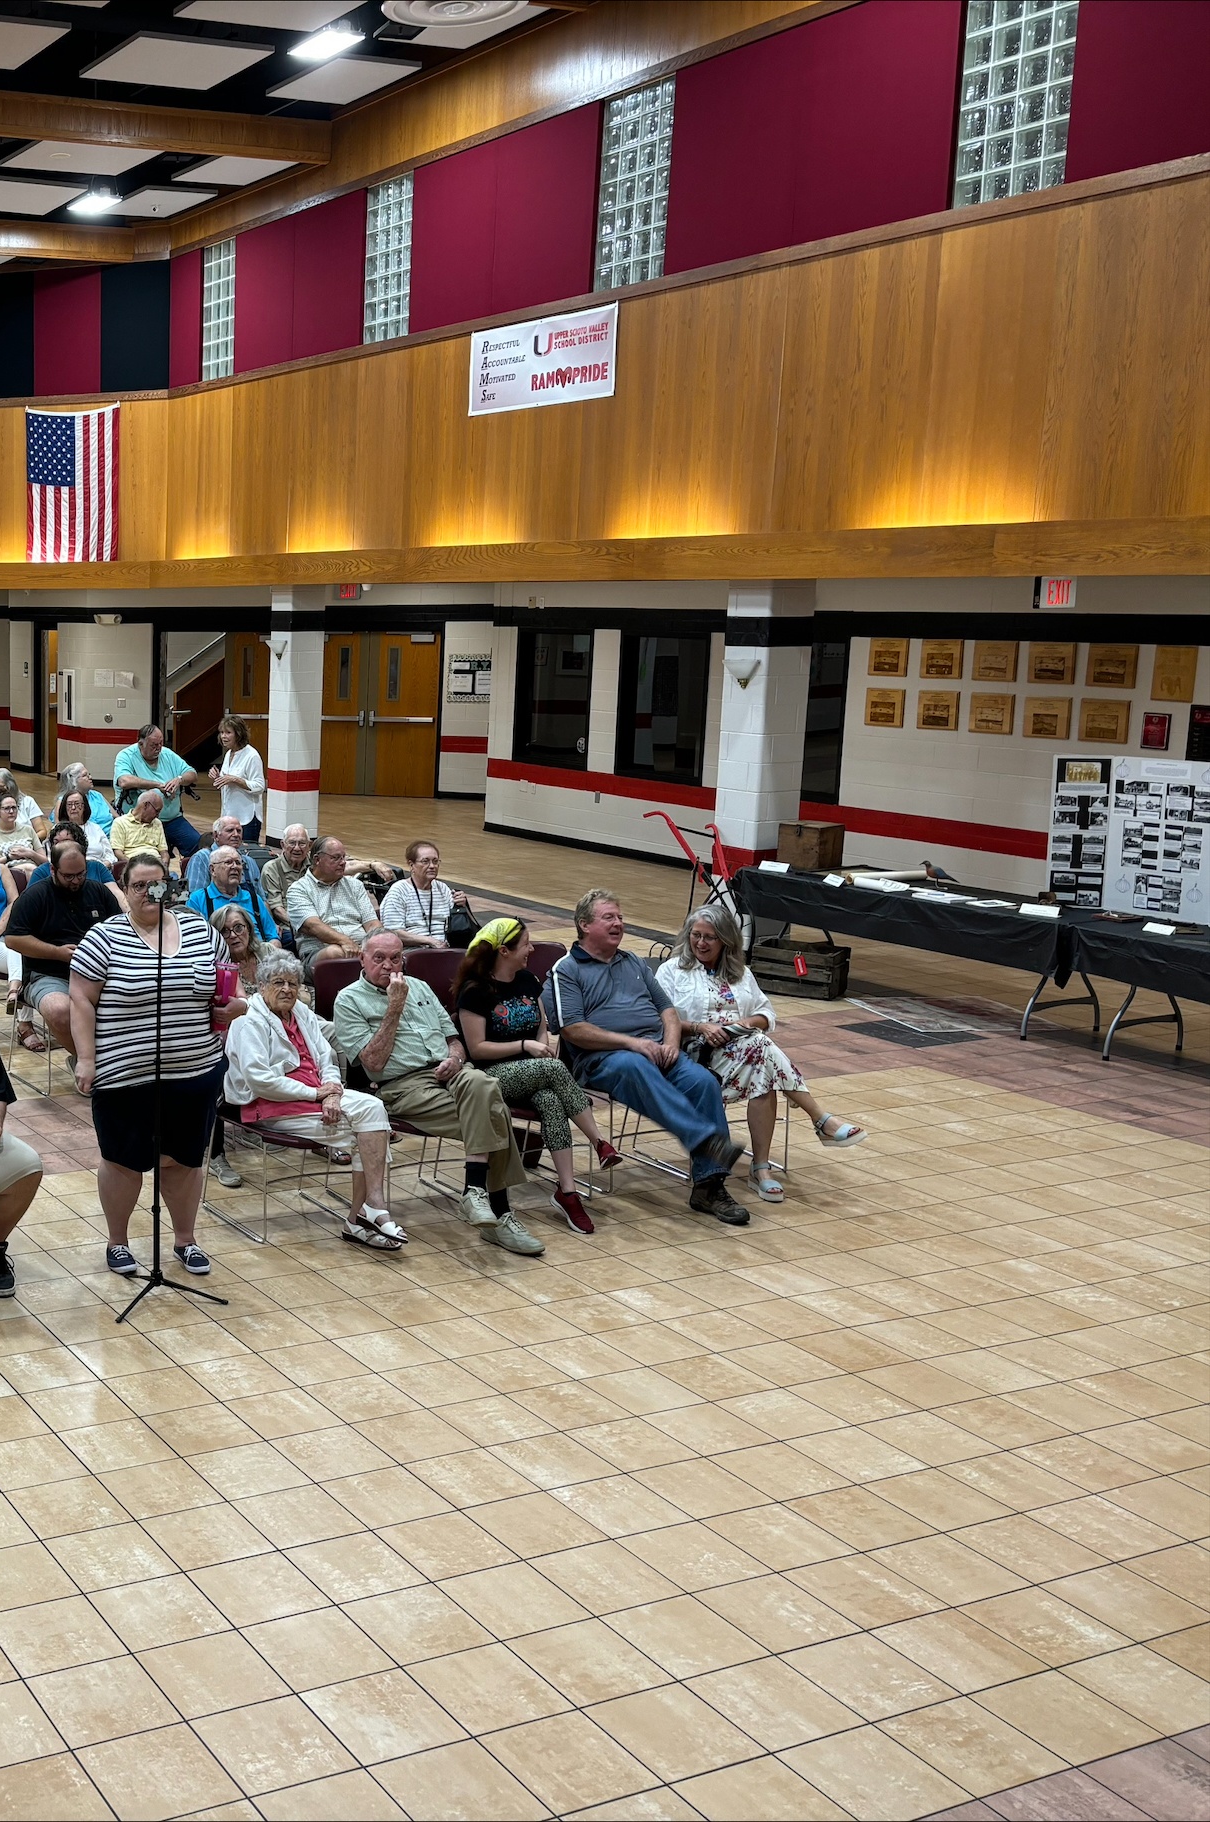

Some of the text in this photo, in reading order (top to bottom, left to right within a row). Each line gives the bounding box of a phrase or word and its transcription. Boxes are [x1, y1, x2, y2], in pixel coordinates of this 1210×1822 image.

[554, 321, 609, 340] UPPER SCIOTO VALLEY
[554, 331, 608, 350] SCHOOL DISTRICT
[572, 361, 609, 385] PRIDE
[1047, 579, 1072, 606] EXIT
